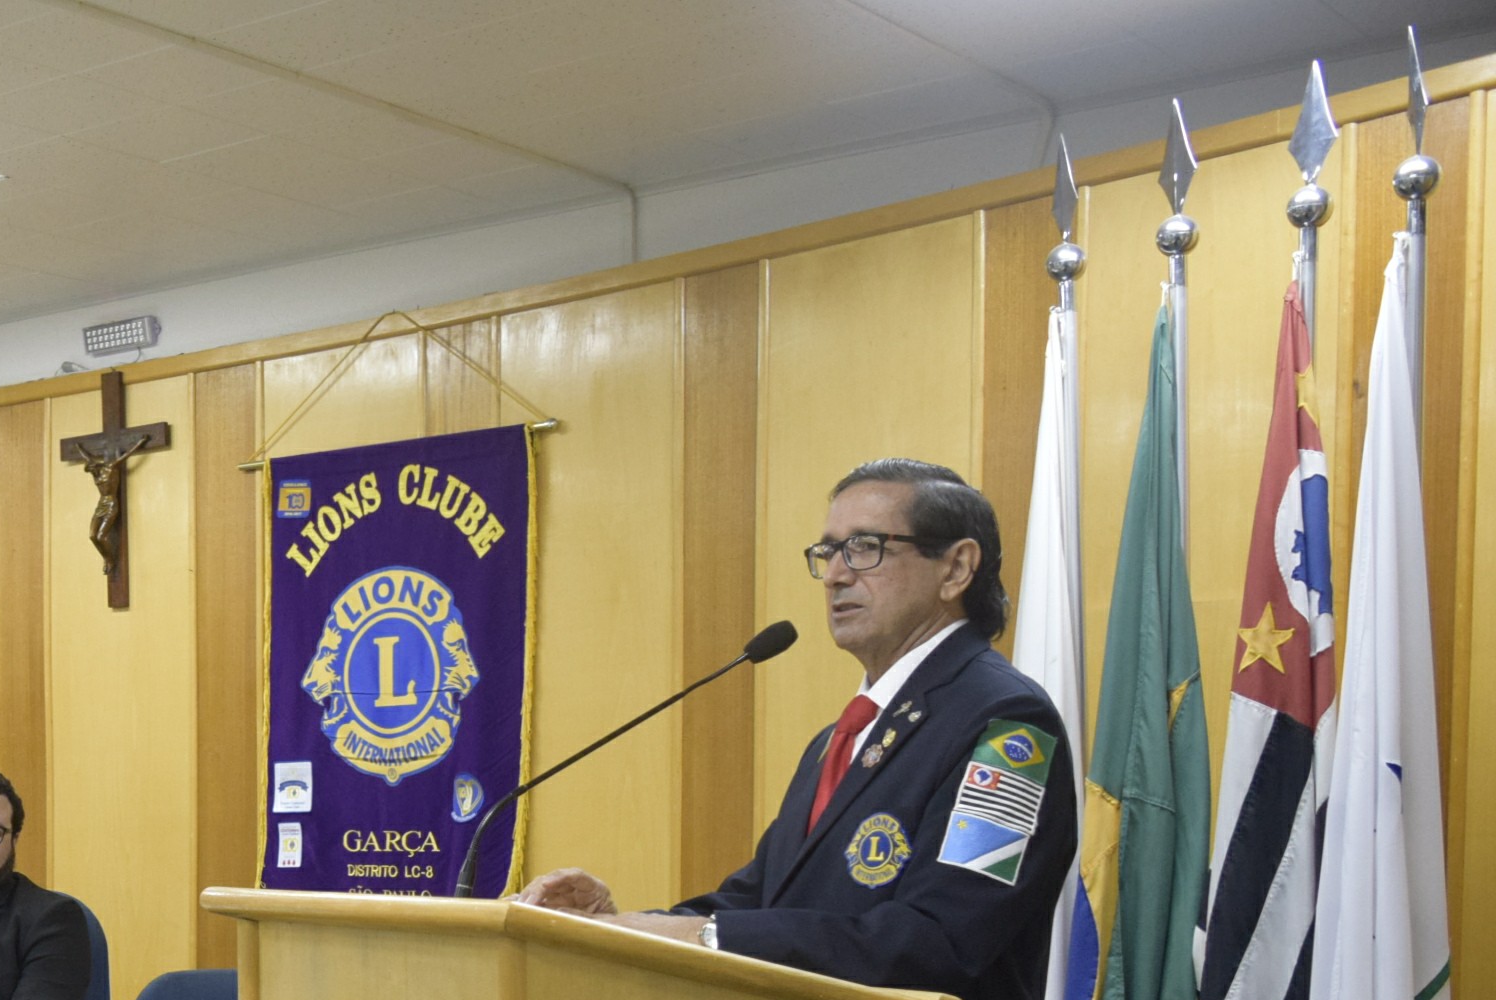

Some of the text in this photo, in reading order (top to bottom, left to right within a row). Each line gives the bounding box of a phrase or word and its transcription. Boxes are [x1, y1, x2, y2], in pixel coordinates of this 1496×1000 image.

[286, 463, 506, 578] LIONS CLUBE
[342, 575, 445, 625] LIONS
[372, 636, 418, 708] L
[343, 727, 446, 767] INTERNATIONAL
[342, 829, 440, 858] GARÇA
[867, 836, 884, 861] L
[347, 863, 434, 878] DISTRITO LC-8
